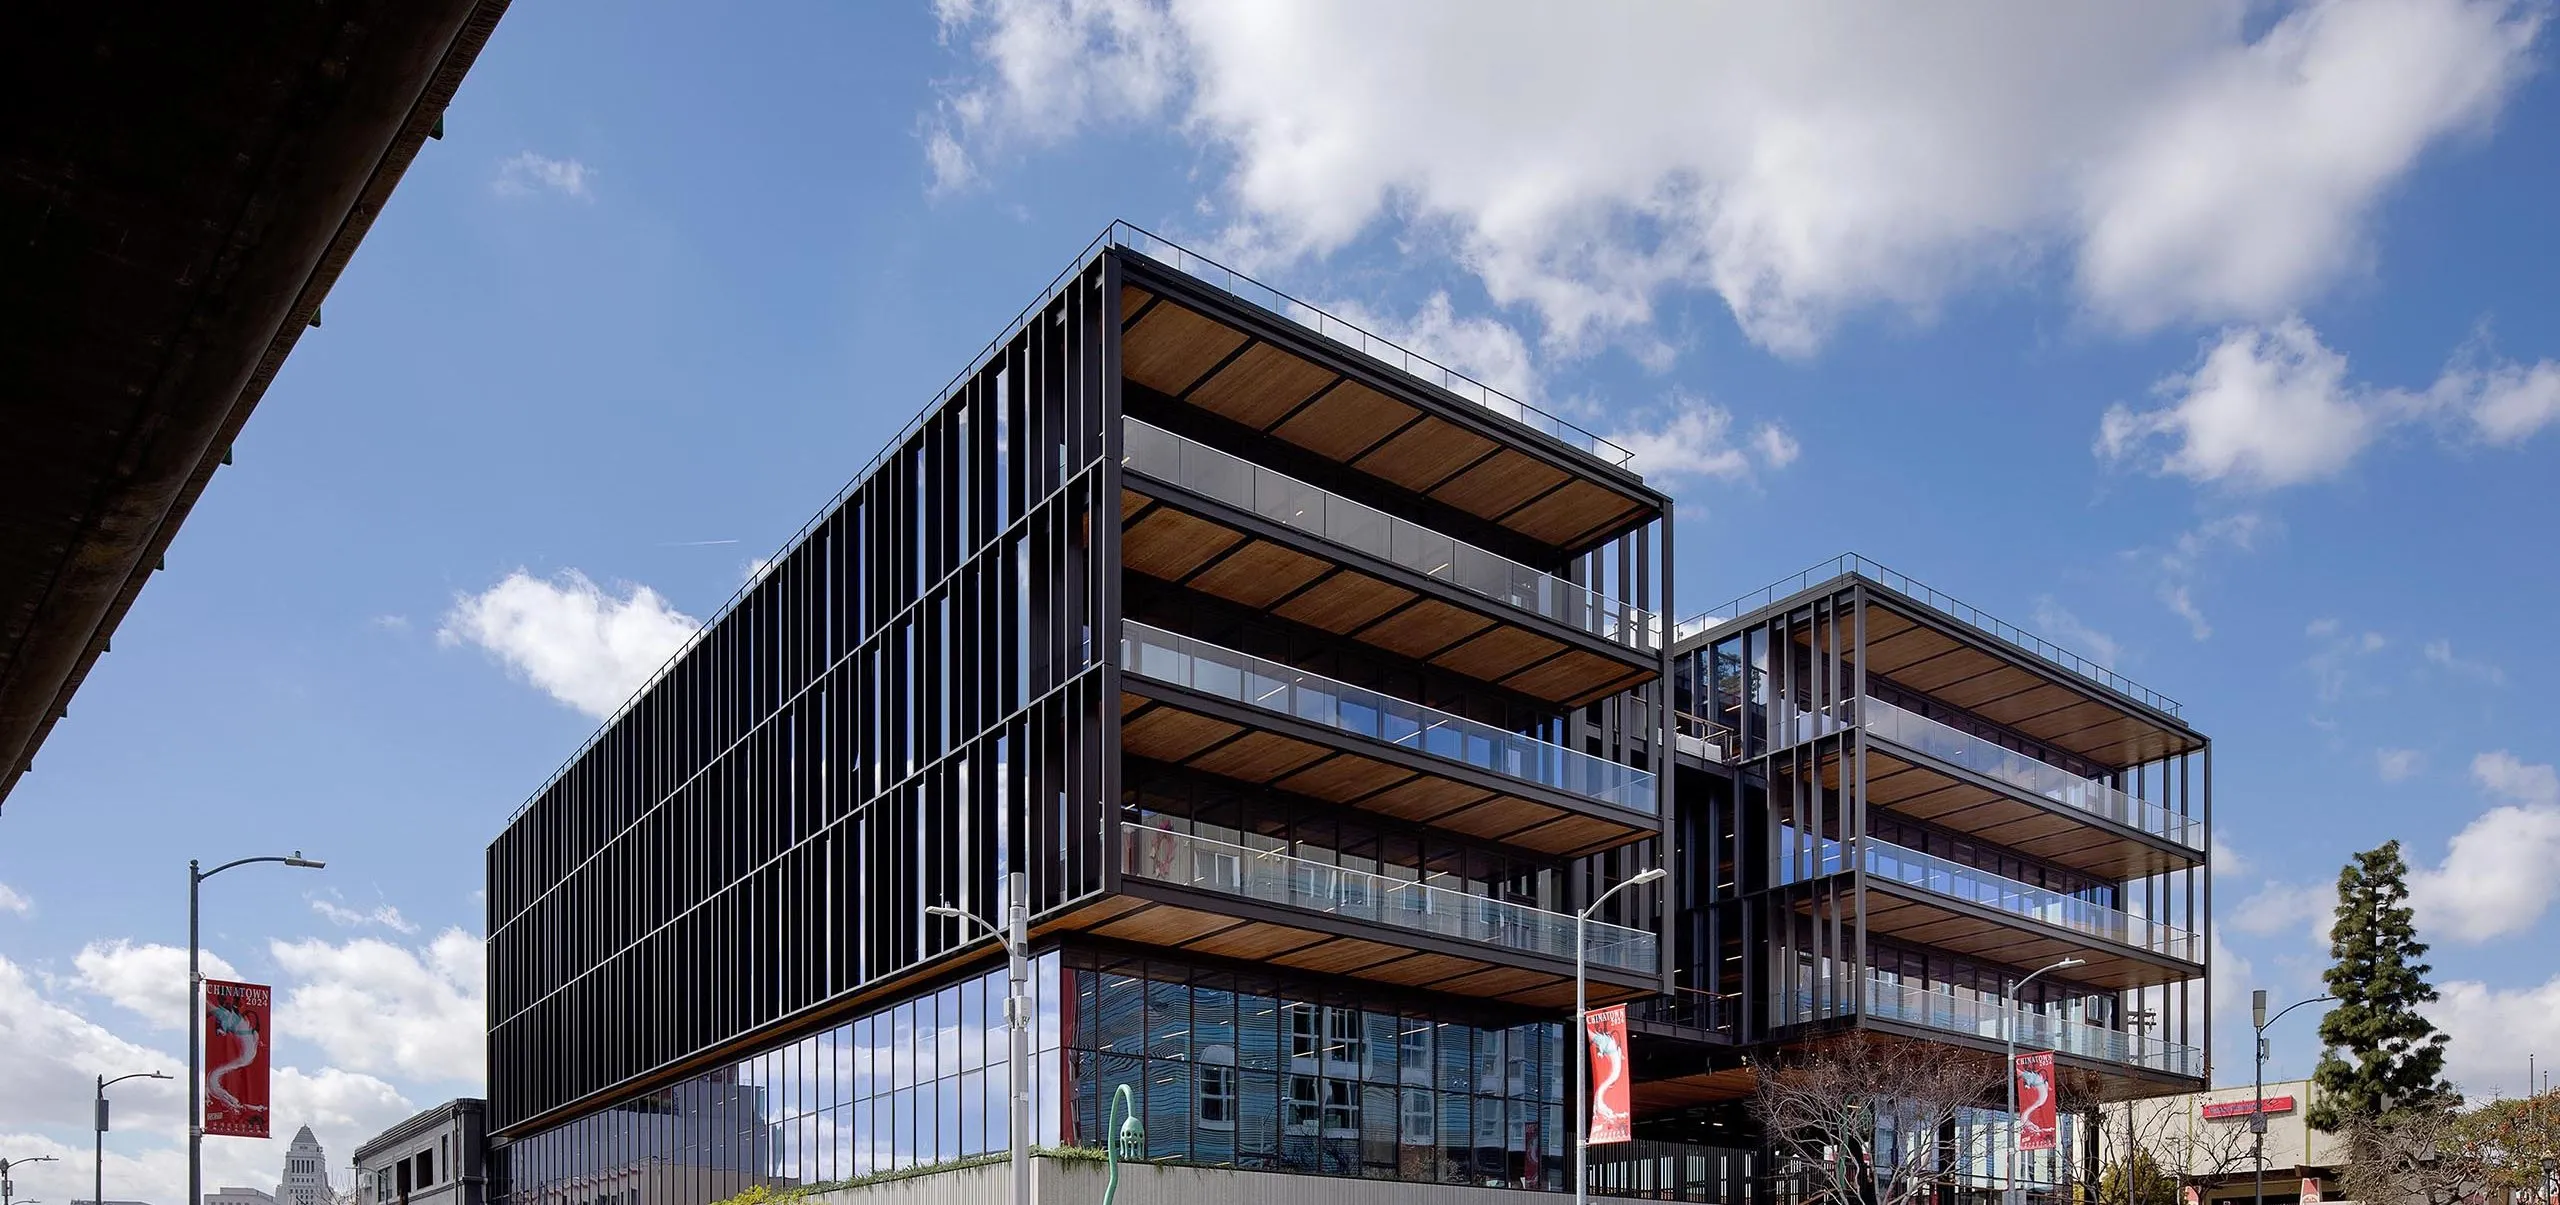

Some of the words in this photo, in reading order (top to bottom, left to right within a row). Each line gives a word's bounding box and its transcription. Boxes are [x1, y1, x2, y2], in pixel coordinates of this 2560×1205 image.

[206, 984, 269, 1000] CHINATOWN
[246, 998, 268, 1007] 2024
[1586, 1009, 1625, 1024] CHINATOWN
[2016, 1054, 2052, 1065] CHINATOWN
